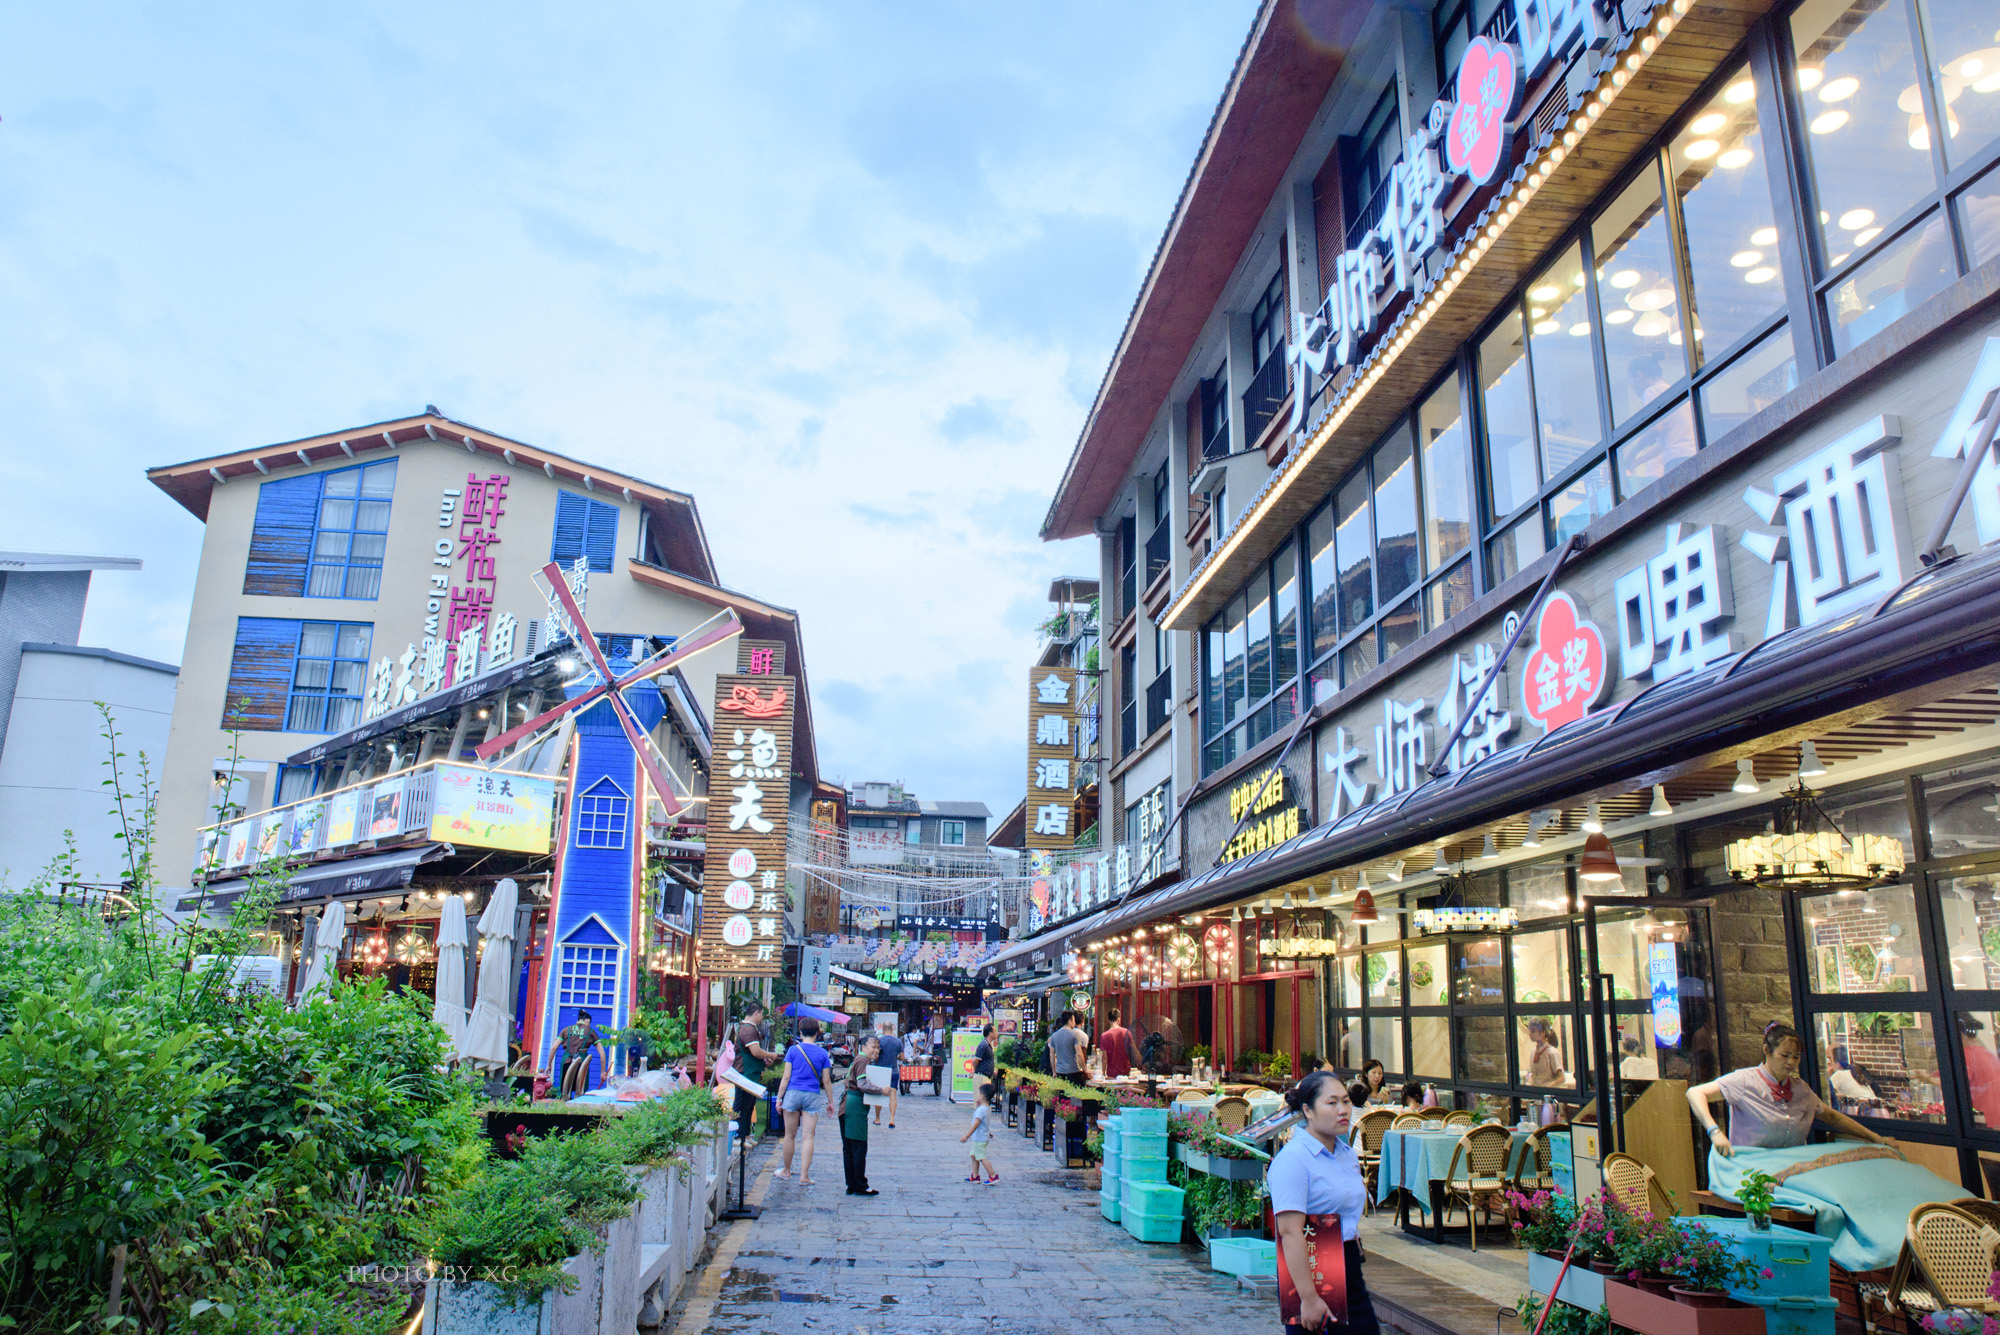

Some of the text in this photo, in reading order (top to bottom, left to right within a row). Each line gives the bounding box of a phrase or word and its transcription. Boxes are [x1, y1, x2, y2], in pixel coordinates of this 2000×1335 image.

[1287, 128, 1443, 434] 大师傅
[1457, 64, 1504, 160] 金奖
[438, 488, 462, 527] Inn
[433, 538, 454, 568] Of
[366, 611, 519, 718] 渔夫啤酒鱼
[1033, 673, 1071, 836] 金鼎酒店
[1325, 643, 1512, 821] 大师傅
[1533, 637, 1592, 715] 金奖
[477, 776, 514, 798] 渔夫
[726, 728, 783, 833] 渔夫
[1139, 785, 1164, 841] 音乐
[1230, 768, 1284, 824] 中央电视台
[729, 854, 752, 940] 啤酒鱼
[757, 870, 778, 963] 音乐餐厅
